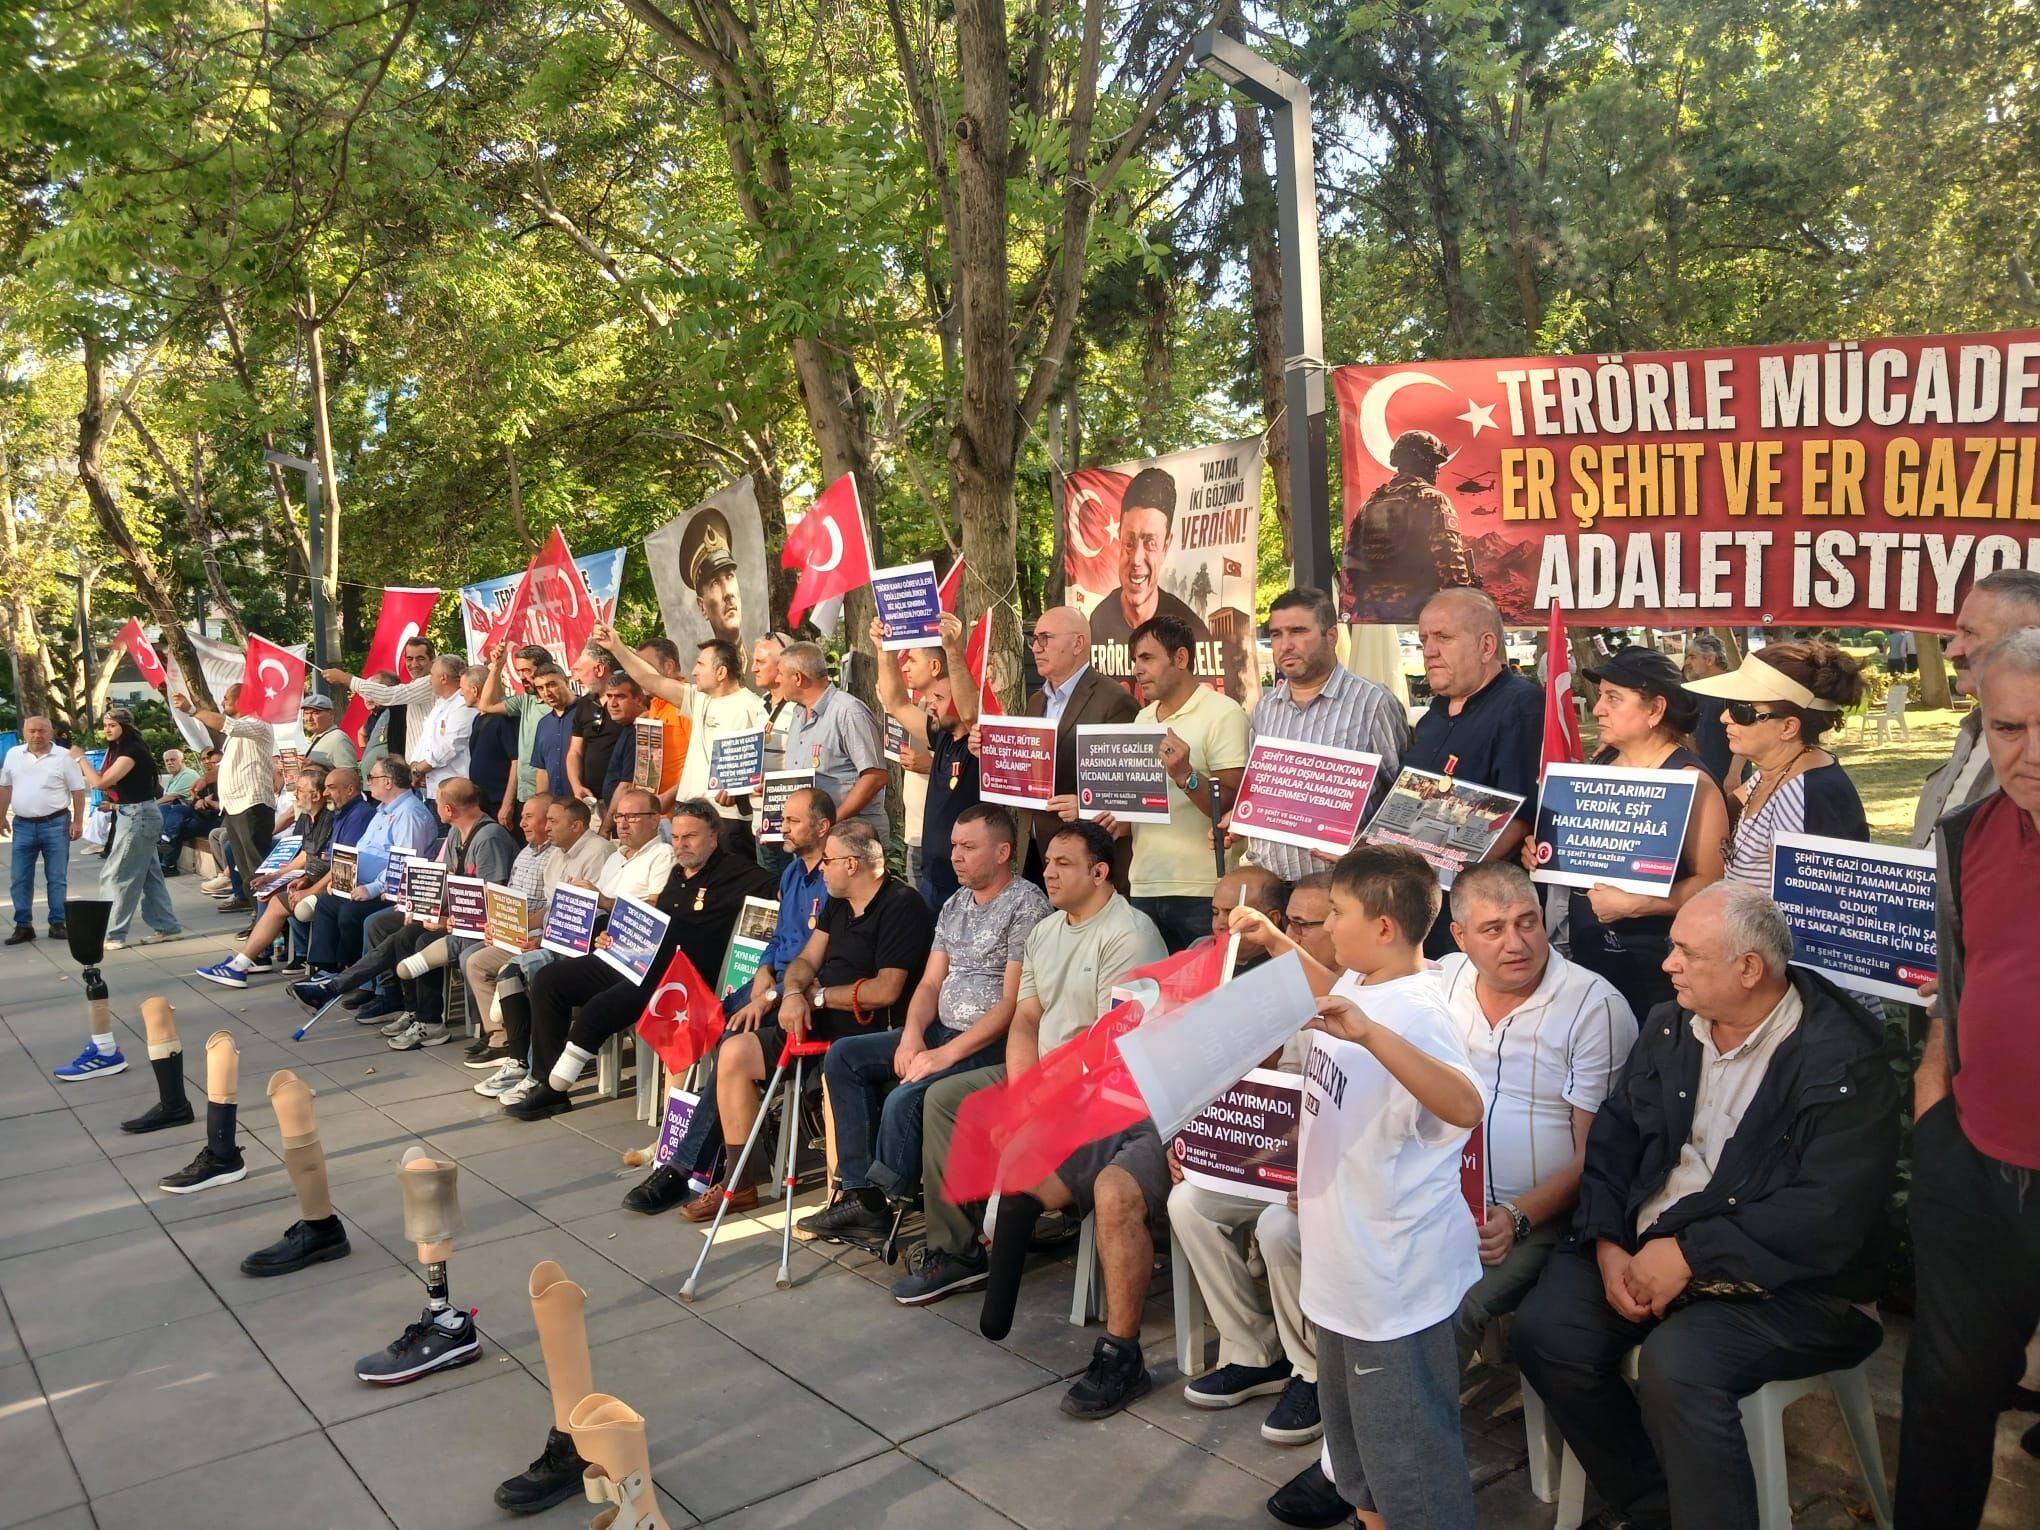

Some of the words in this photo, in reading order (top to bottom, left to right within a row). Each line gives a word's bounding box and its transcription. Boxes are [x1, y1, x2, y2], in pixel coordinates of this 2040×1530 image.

[1498, 355, 1737, 437] TERÖRLE
[1205, 481, 1245, 509] GÖZÜMÜ
[1501, 448, 1556, 521] ER
[1569, 442, 1704, 528] ŞEHİT
[1719, 441, 1783, 516] VE
[1802, 439, 1866, 516] ER
[1534, 531, 1774, 611] ADALET
[1793, 530, 2040, 614] İSTİYO
[989, 733, 1017, 746] "ADALET,
[1017, 734, 1040, 747] RÜTBE
[1089, 743, 1110, 756] ŞEHİT
[1111, 744, 1121, 754] VE
[1122, 742, 1153, 754] GAZİLER
[999, 746, 1011, 759] EŞİT
[1012, 749, 1050, 761] HAKLARLA
[1080, 758, 1117, 768] ARASINDA
[1118, 758, 1165, 770] AYRIMCILIK,
[1262, 750, 1283, 764] ŞEHİT
[1284, 753, 1294, 764] VE
[1294, 754, 1314, 768] GAZİ
[1315, 760, 1364, 776] OLDUKTAN
[1080, 769, 1124, 782] VİCDANLARI
[1125, 772, 1163, 783] YARALAR!
[1250, 760, 1277, 773] SONRA
[1278, 764, 1297, 776] KAPI
[1297, 767, 1325, 782] DIŞINA
[1326, 772, 1370, 789] ATILARAK
[1255, 772, 1269, 786] EŞİT
[1270, 775, 1303, 790] HAKLAR
[1304, 780, 1354, 799] ALMAMIZIN
[1249, 784, 1308, 803] ENGELLENMESİ
[1308, 794, 1353, 812] VEBALDİR!
[1570, 781, 1667, 799] "EVLATLARIMIZI
[1575, 799, 1621, 815] VERDİK,
[1625, 803, 1652, 818] EŞİT
[1552, 815, 1631, 833] HAKLARIMIZI
[1633, 820, 1668, 836] HÂLÂ
[1565, 834, 1641, 852] ALAMADIK!"
[1570, 859, 1609, 869] PLATFORMU
[1598, 851, 1626, 862] GAZİLER
[1794, 851, 1821, 864] ŞEHİT
[1822, 856, 1834, 867] VE
[1836, 858, 1859, 870] GAZİ
[1861, 863, 1903, 877] OLARAK
[1798, 866, 1853, 883] GÖREVİMİZİ
[1856, 876, 1931, 897] TAMAMLADIK!
[1785, 877, 1832, 894] ORDUDAN
[1834, 885, 1847, 896] VE
[1848, 887, 1904, 906] HAYATTAN
[1907, 897, 1936, 912] TERH
[1839, 900, 1878, 916] OLDUK!
[1805, 905, 1855, 925] HİYERARŞİ
[1857, 915, 1895, 933] DİRİLER
[1898, 922, 1920, 938] İÇİN
[1794, 918, 1806, 928] VE
[1807, 920, 1838, 935] SAKAT
[1839, 928, 1889, 946] ASKERLER
[1891, 936, 1913, 950] İÇİN
[1817, 947, 1840, 959] ŞEHİT
[1843, 952, 1853, 961] VE
[1855, 954, 1890, 970] GAZİLER
[1823, 958, 1871, 975] PLATFORMU
[1228, 1091, 1295, 1119] AYIRMADI,
[1183, 1120, 1212, 1138] EDEN
[1215, 1126, 1288, 1152] AYIRIYOR?"
[1207, 1160, 1245, 1175] PLATFORMU
